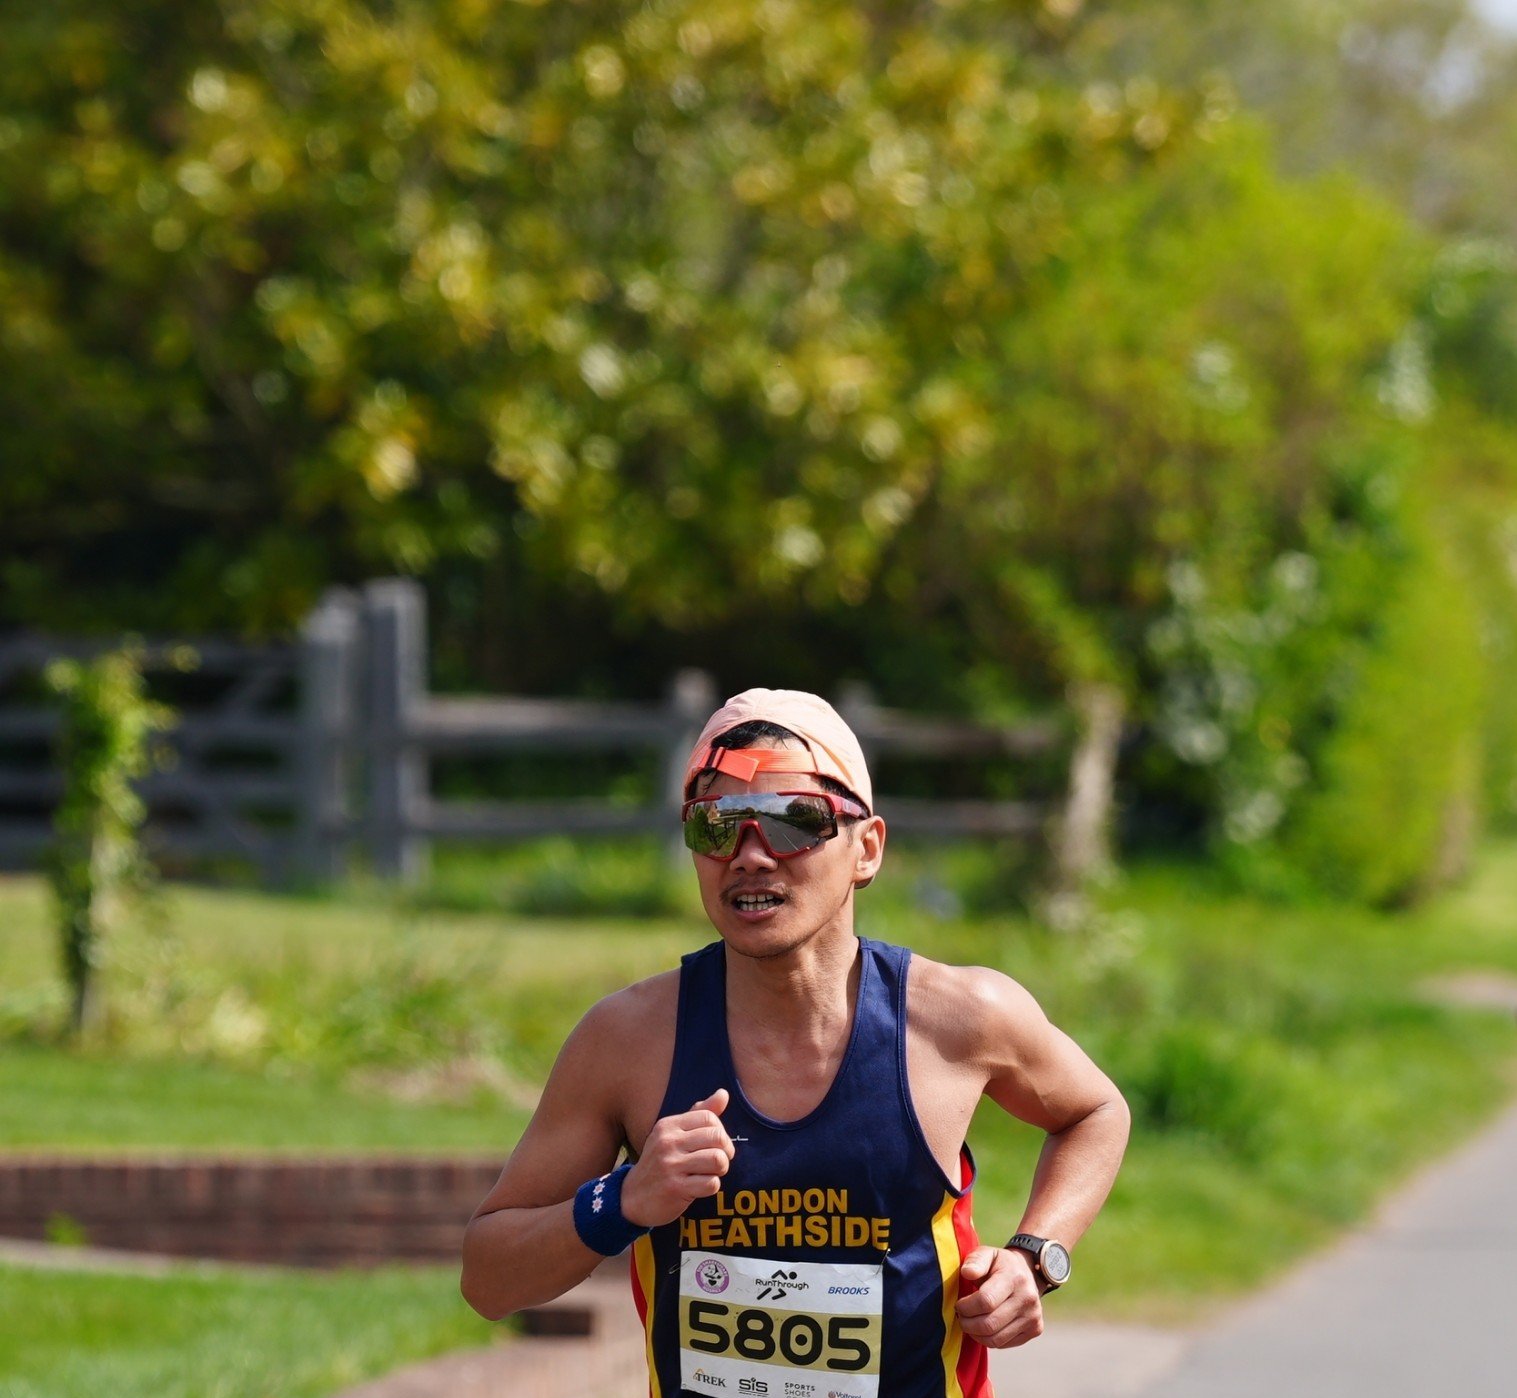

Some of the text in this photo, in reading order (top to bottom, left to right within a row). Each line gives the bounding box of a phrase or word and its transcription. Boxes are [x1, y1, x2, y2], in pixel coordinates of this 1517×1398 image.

[716, 1188, 848, 1216] LONDON
[679, 1217, 890, 1250] HEATHSIDE
[755, 1278, 810, 1290] RunThrough
[828, 1286, 870, 1295] BROOKS
[689, 1300, 871, 1371] 5805
[695, 1372, 727, 1388] TREK
[739, 1377, 768, 1393] SiS
[784, 1382, 815, 1391] SPORTS
[784, 1389, 811, 1398] SHOES
